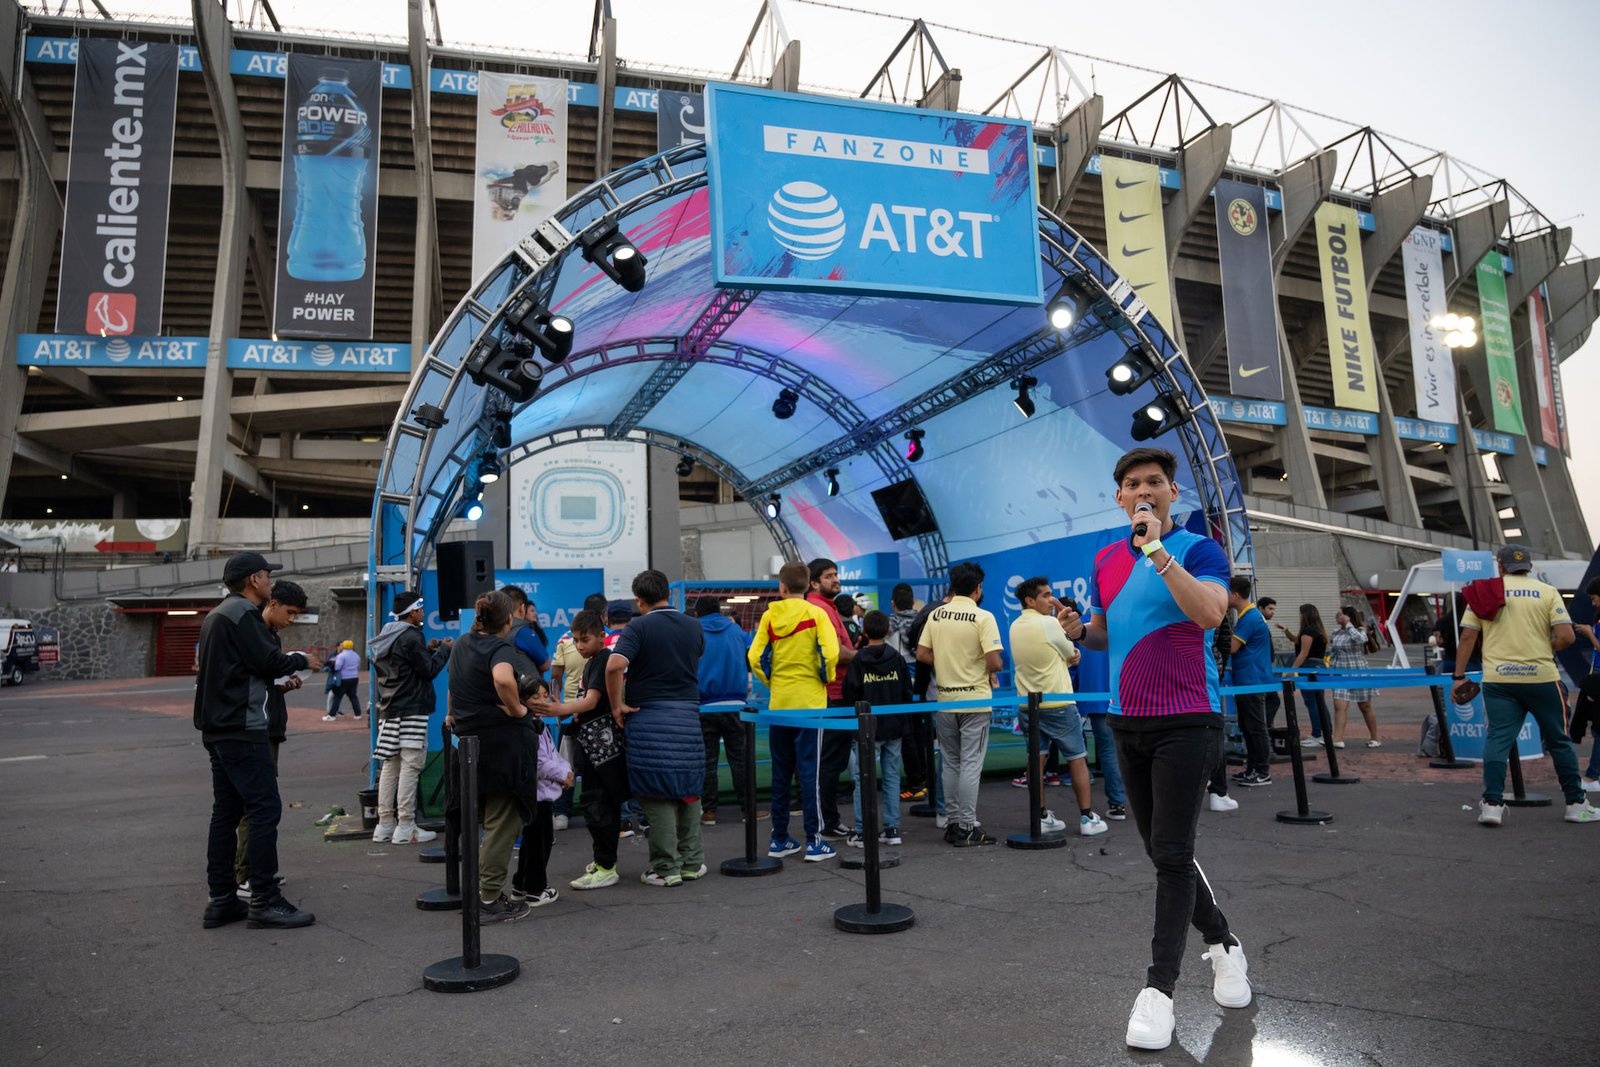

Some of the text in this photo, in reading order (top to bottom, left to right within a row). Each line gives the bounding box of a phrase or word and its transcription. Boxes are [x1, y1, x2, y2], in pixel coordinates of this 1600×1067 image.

[37, 41, 79, 60] AT&
[247, 54, 287, 75] AT&
[440, 73, 478, 92] AT&
[625, 91, 659, 108] AT&
[297, 105, 368, 126] POWER
[297, 120, 336, 134] ADE
[786, 132, 969, 168] FANZONE
[96, 41, 148, 288] caliente.mx
[1412, 232, 1436, 249] GNP
[304, 292, 345, 305] #HAY
[1328, 223, 1366, 392] NIKE FUTBOL
[292, 307, 355, 321] POWER
[34, 340, 199, 361] AT&T AT&T
[242, 344, 400, 366] AT&T AT&T
[1425, 346, 1436, 362] es
[1424, 367, 1440, 409] Vivir
[1248, 404, 1277, 420] AT&T
[1304, 409, 1370, 430] T&T AT&T
[1466, 560, 1482, 571] AT&T
[1506, 589, 1540, 599] rona
[932, 607, 977, 623] Corona
[1451, 723, 1484, 738] AT&T
